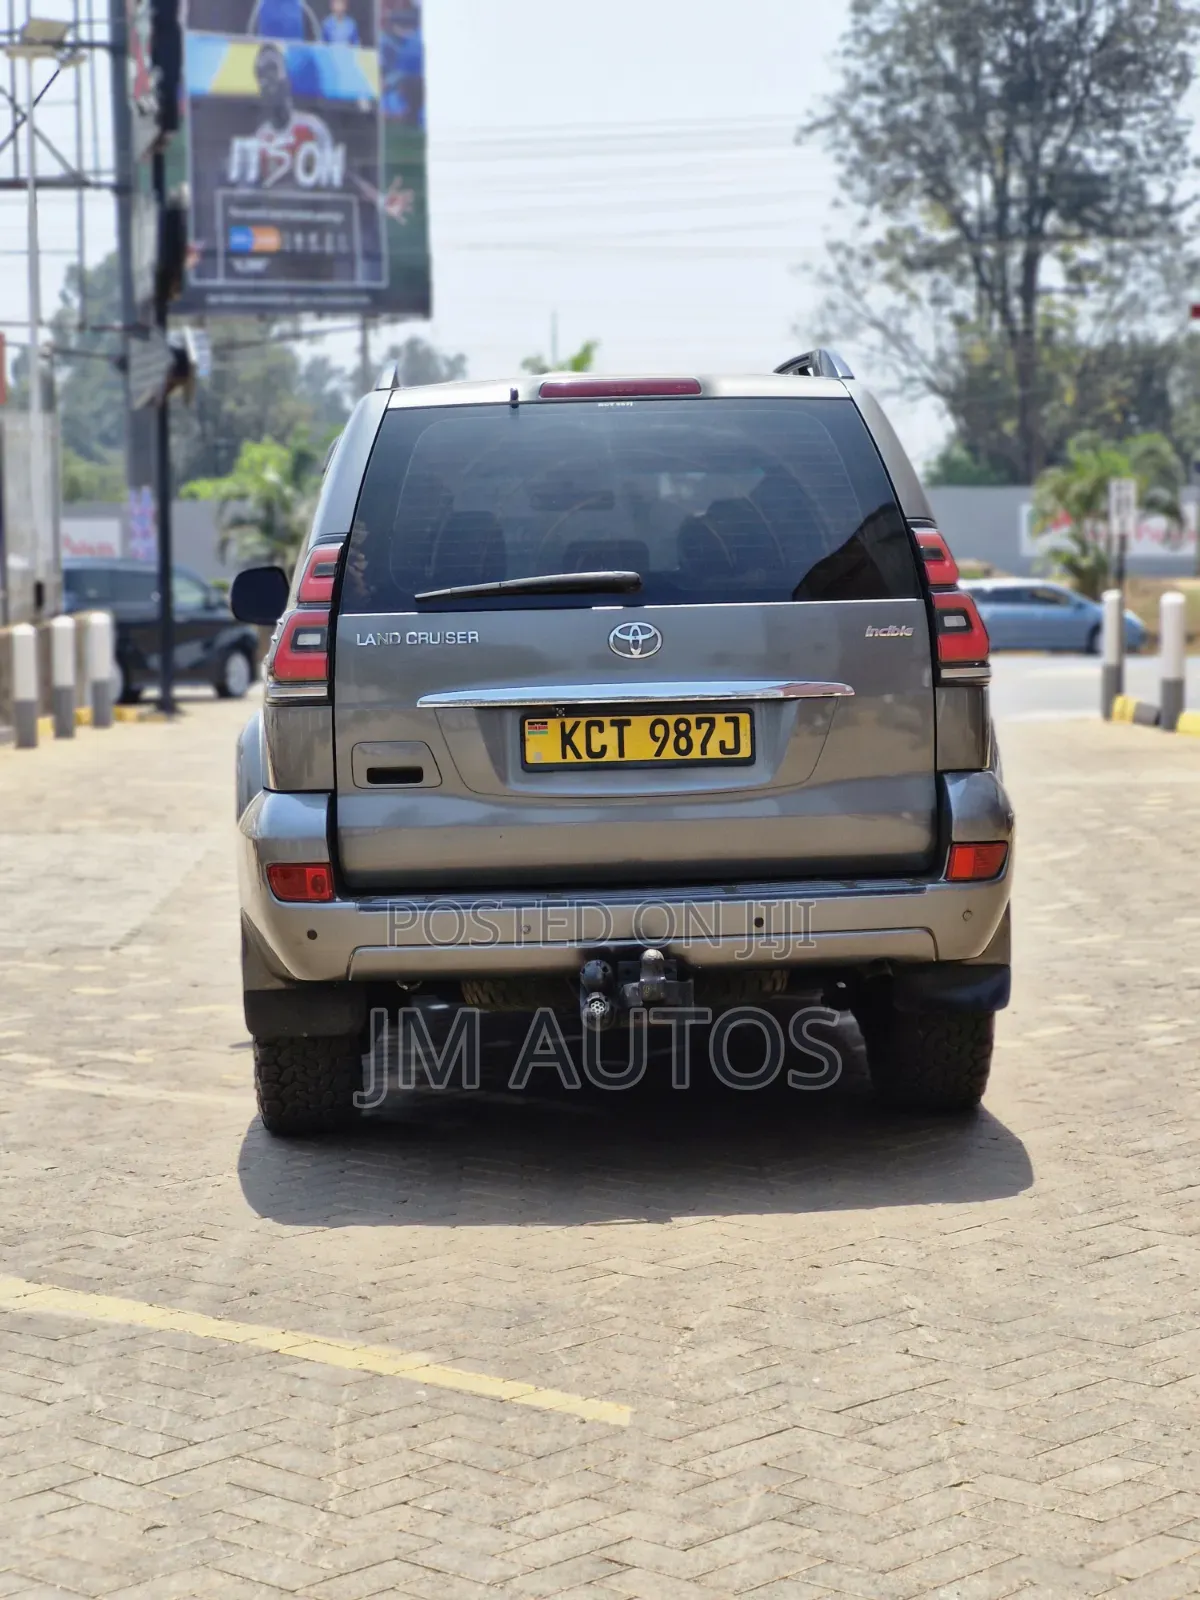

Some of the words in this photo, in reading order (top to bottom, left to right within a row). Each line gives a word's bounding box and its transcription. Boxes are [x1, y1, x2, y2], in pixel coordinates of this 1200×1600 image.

[356, 632, 402, 646] LAND
[405, 631, 479, 645] CRUISER
[560, 718, 632, 760] KCT
[649, 716, 742, 758] 987J
